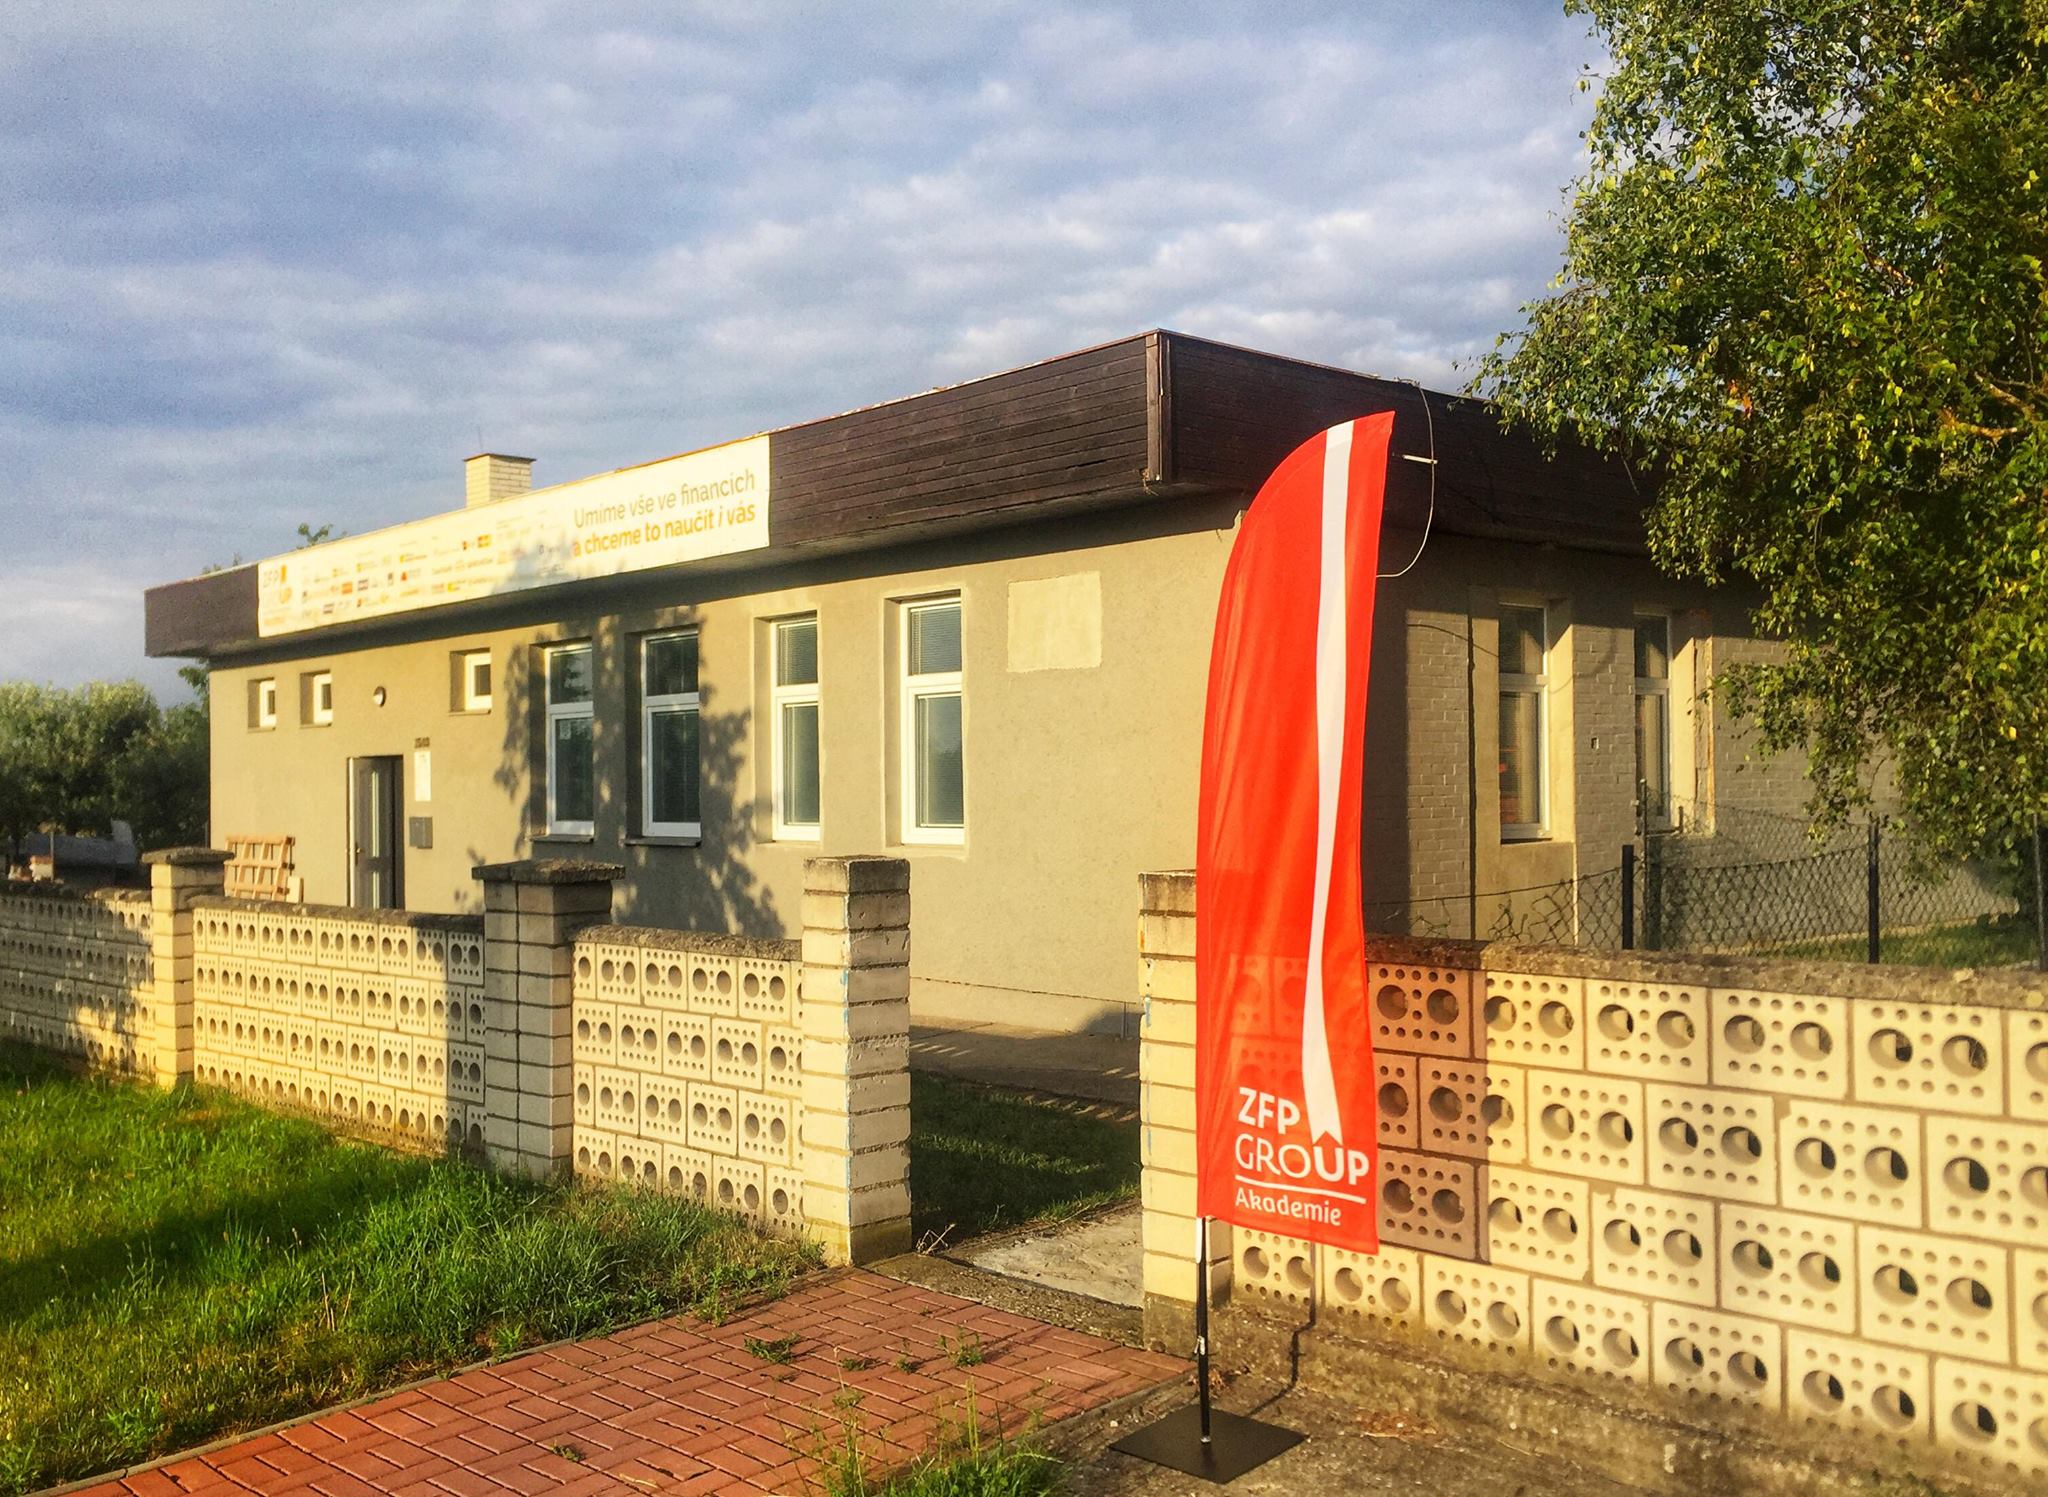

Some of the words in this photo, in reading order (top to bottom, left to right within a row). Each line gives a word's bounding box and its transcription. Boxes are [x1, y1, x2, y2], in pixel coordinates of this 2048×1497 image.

[573, 540, 582, 557] a
[585, 527, 641, 555] chceme
[645, 521, 661, 542] to
[664, 508, 714, 538] naučit
[727, 499, 756, 525] vás
[629, 493, 654, 516] vše
[657, 492, 676, 510] ve
[1238, 1086, 1300, 1134] ZFP
[1235, 1133, 1369, 1185] GROUP
[1235, 1187, 1341, 1226] Akademie
